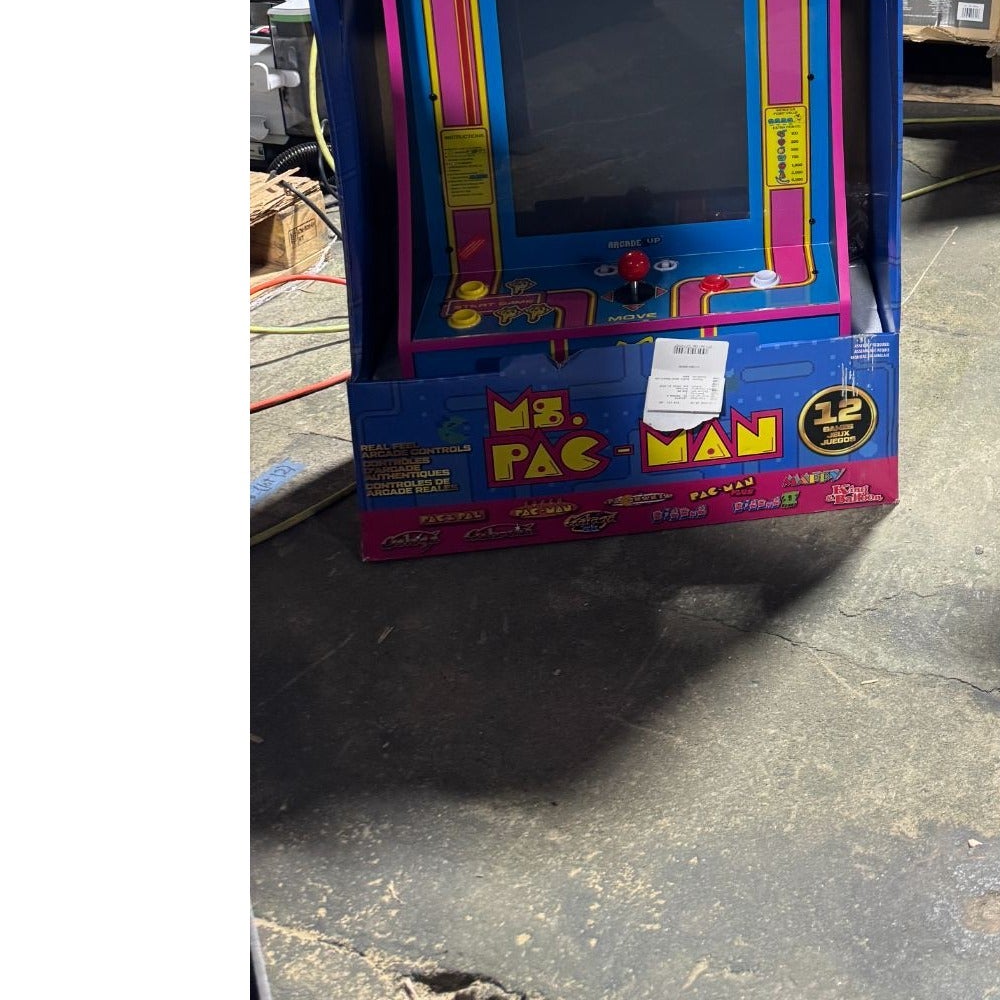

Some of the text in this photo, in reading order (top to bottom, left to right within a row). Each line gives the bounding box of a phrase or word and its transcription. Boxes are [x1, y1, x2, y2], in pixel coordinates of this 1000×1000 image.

[607, 311, 657, 323] MOVE
[813, 397, 862, 426] 12
[822, 423, 854, 433] GAMES
[827, 430, 850, 439] JEUX
[820, 436, 856, 446] JUEGOS
[360, 443, 390, 452] REAL
[361, 444, 471, 459] ARCADE CONTROLS
[364, 469, 450, 481] AUTHENTIQUES
[782, 468, 847, 488] MAPPY
[364, 478, 450, 490] CONTROLES DE
[689, 477, 756, 501] PAC-MAN
[831, 483, 870, 497] King
[366, 487, 413, 497] ARCADE
[834, 492, 884, 505] Balloon
[514, 503, 574, 517] PAC-MAN
